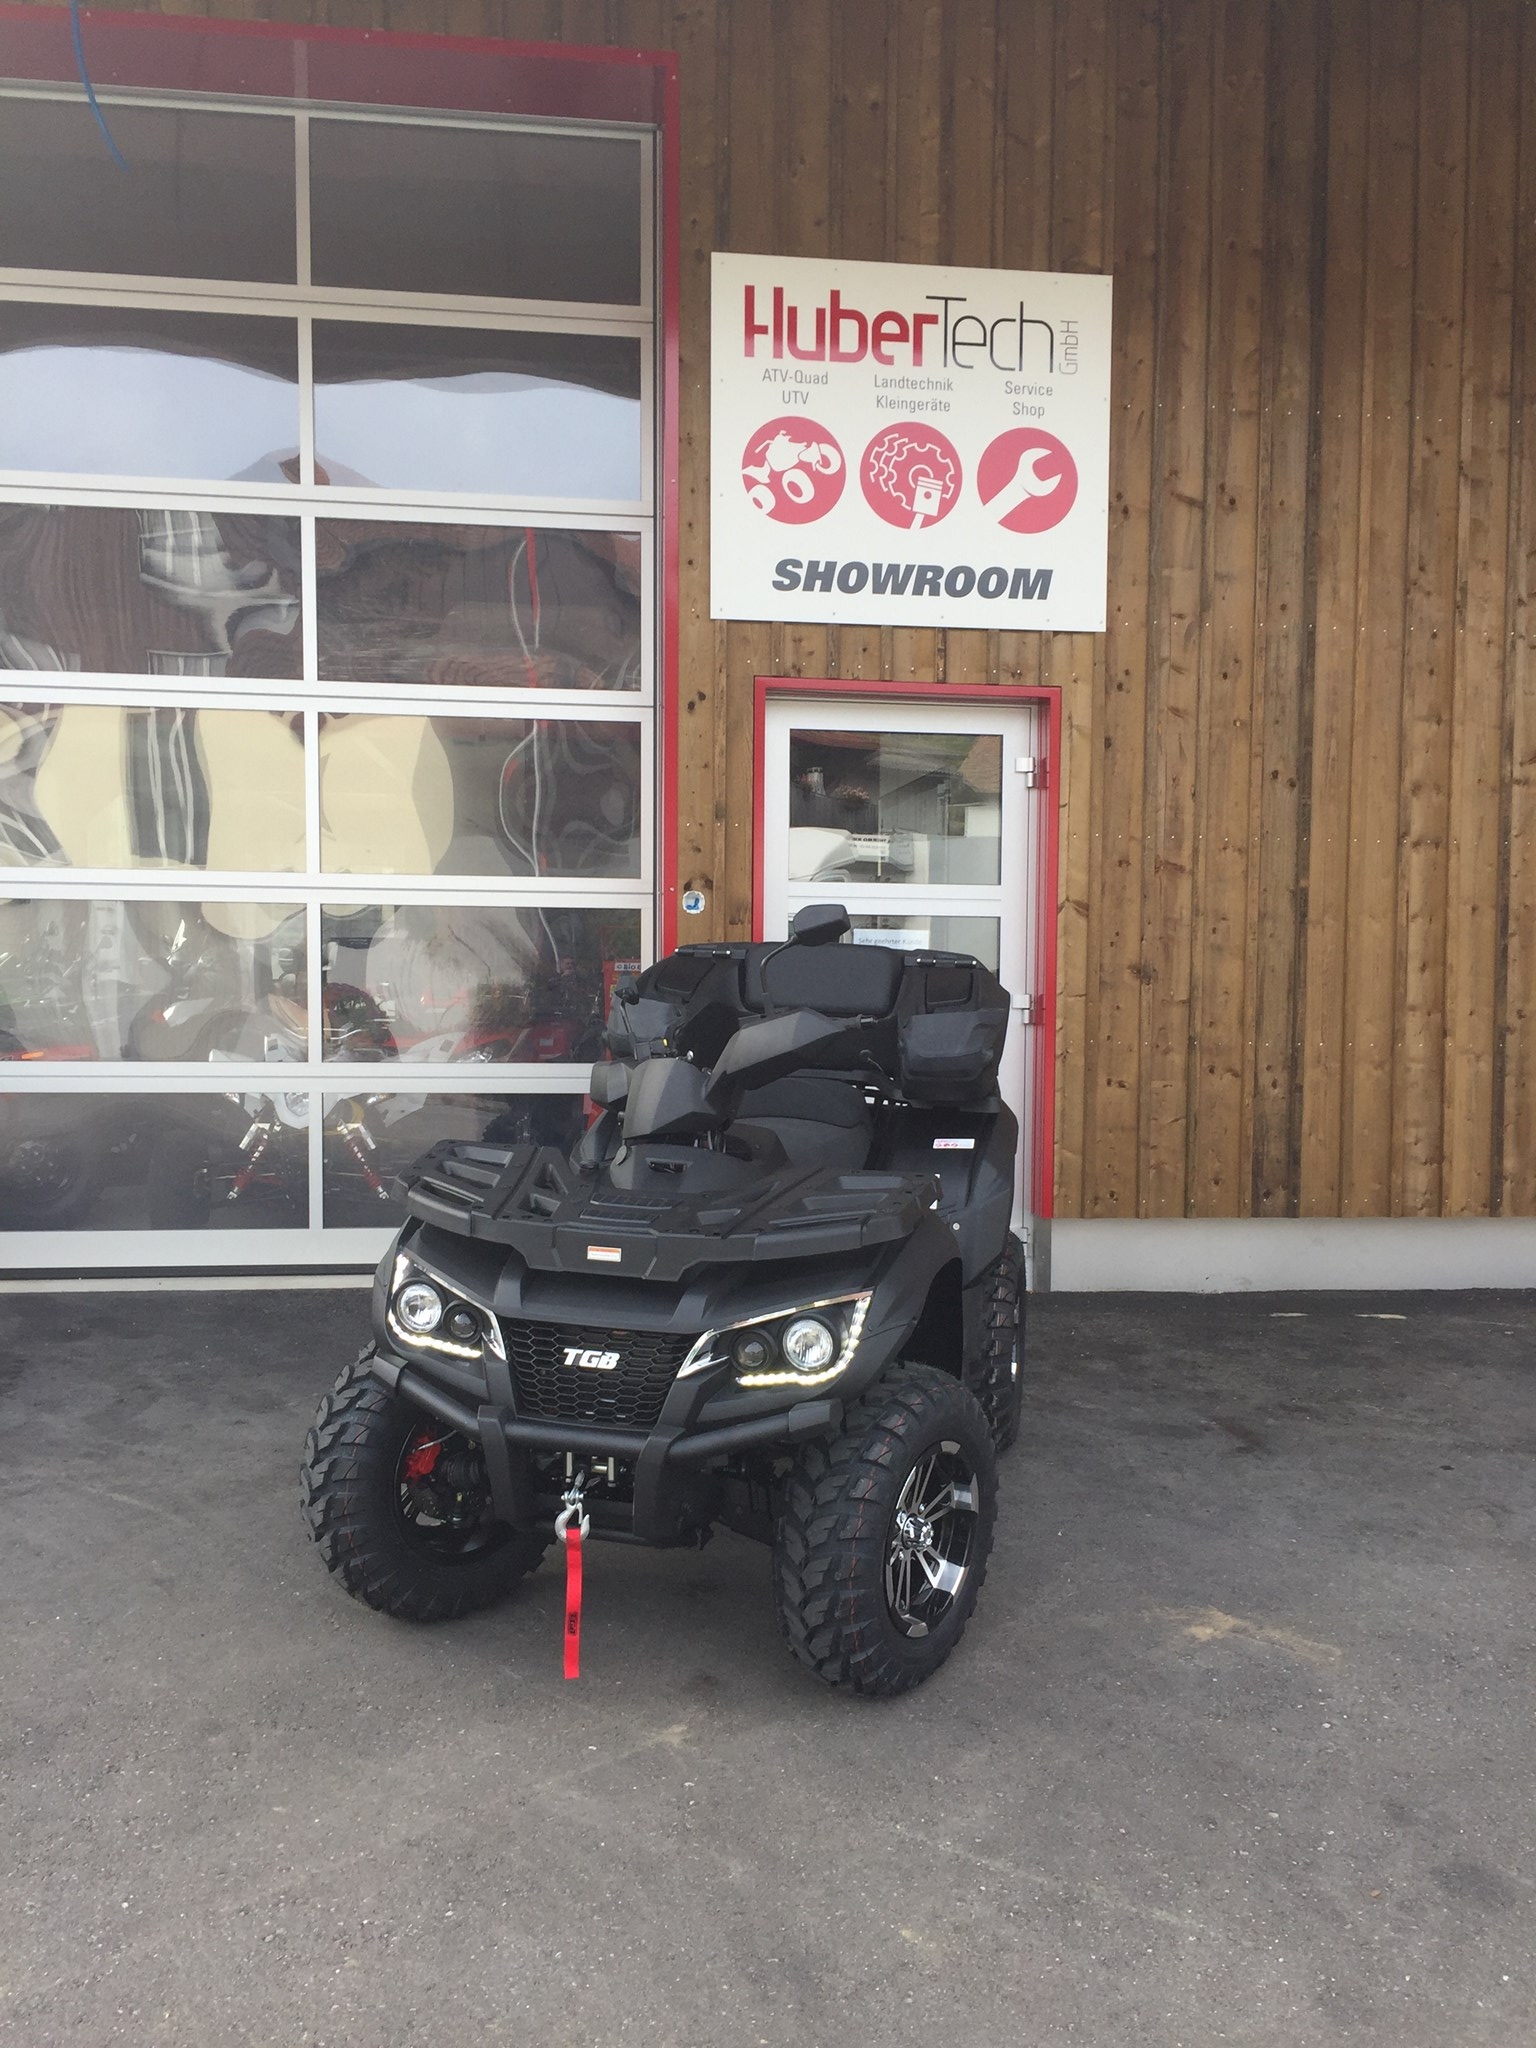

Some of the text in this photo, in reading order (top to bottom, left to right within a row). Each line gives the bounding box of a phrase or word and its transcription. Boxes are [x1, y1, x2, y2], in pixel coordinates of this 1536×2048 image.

[1058, 319, 1079, 375] GmbH
[762, 368, 829, 385] ATV-Quad
[874, 374, 954, 393] Landtechnik
[782, 390, 810, 405] UTV
[1004, 380, 1054, 397] Service
[876, 395, 951, 413] Kleingeräte
[1012, 401, 1046, 419] Shop
[772, 558, 1054, 601] SHOWROOM
[563, 1347, 620, 1370] TGB
